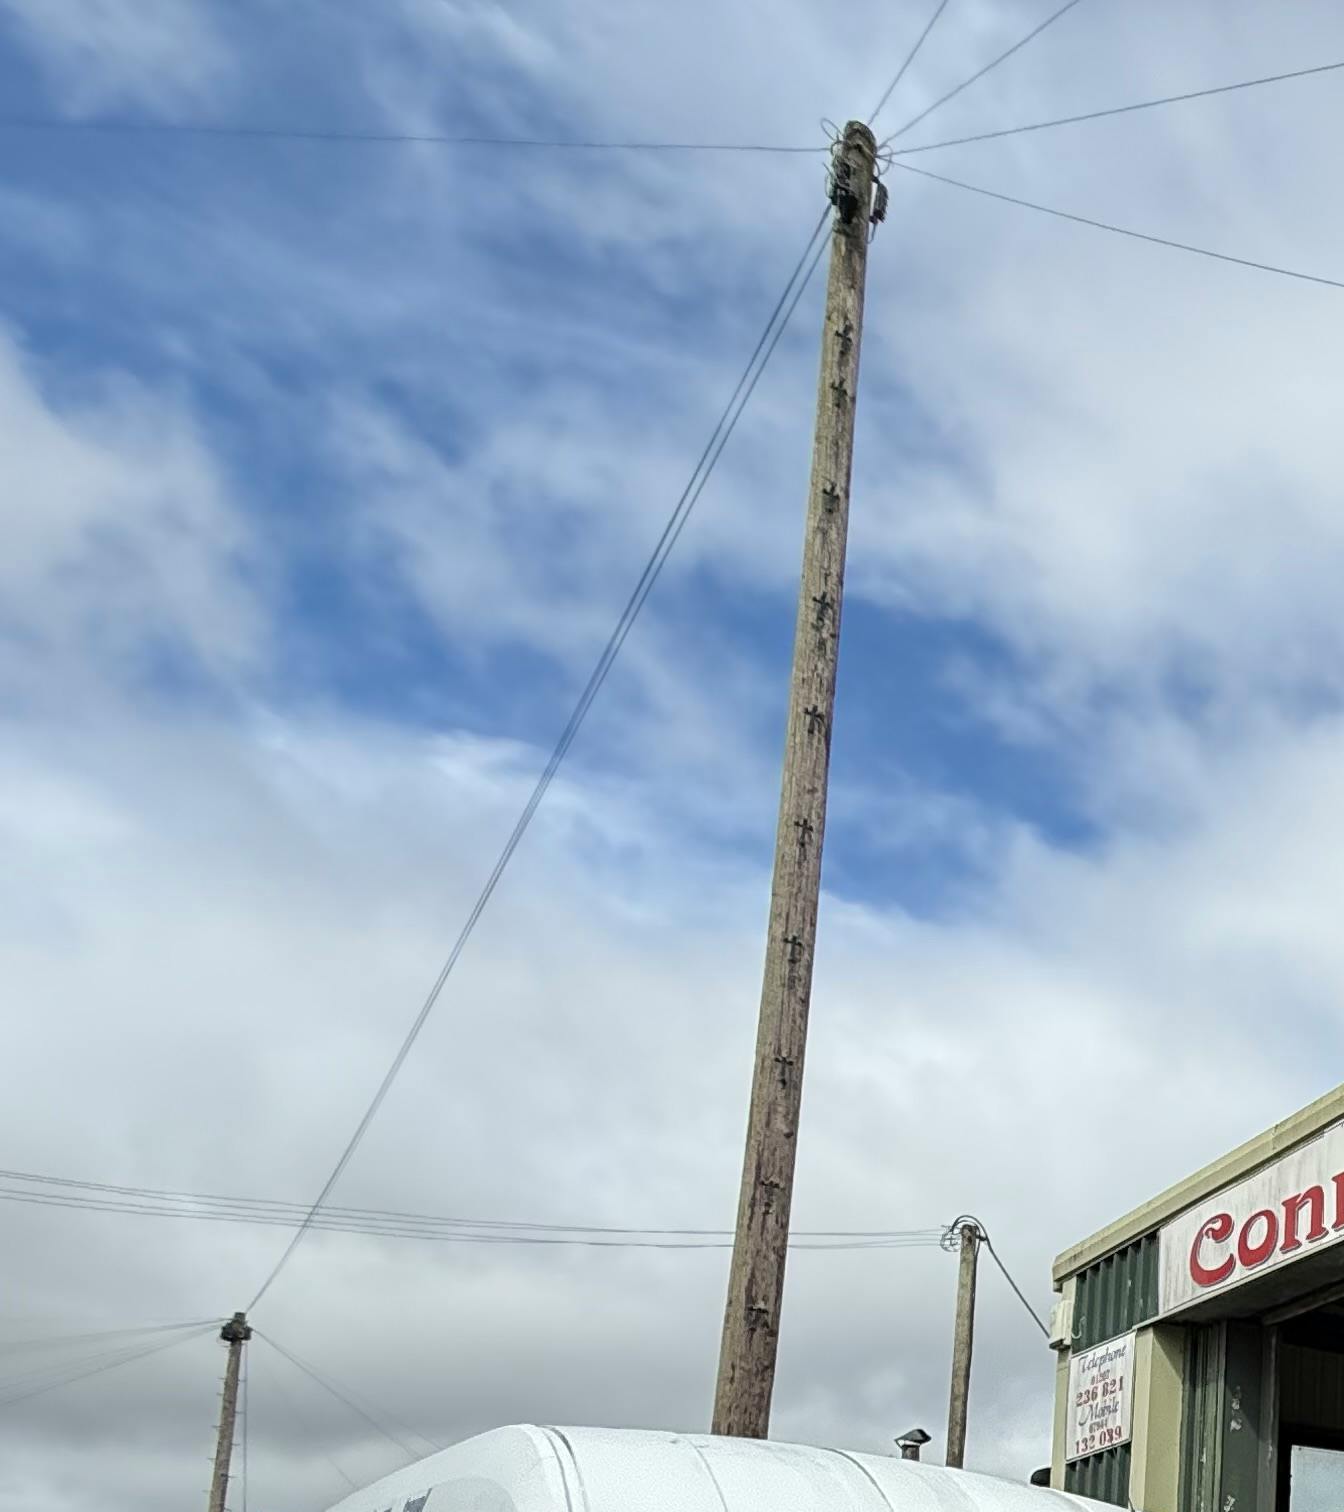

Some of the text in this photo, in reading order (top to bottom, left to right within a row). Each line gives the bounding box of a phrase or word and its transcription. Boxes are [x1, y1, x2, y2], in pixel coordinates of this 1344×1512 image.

[1079, 1345, 1127, 1373] Telephone
[1076, 1376, 1124, 1407] 236 821
[1078, 1396, 1119, 1427] Mobile
[1075, 1434, 1096, 1454] 132
